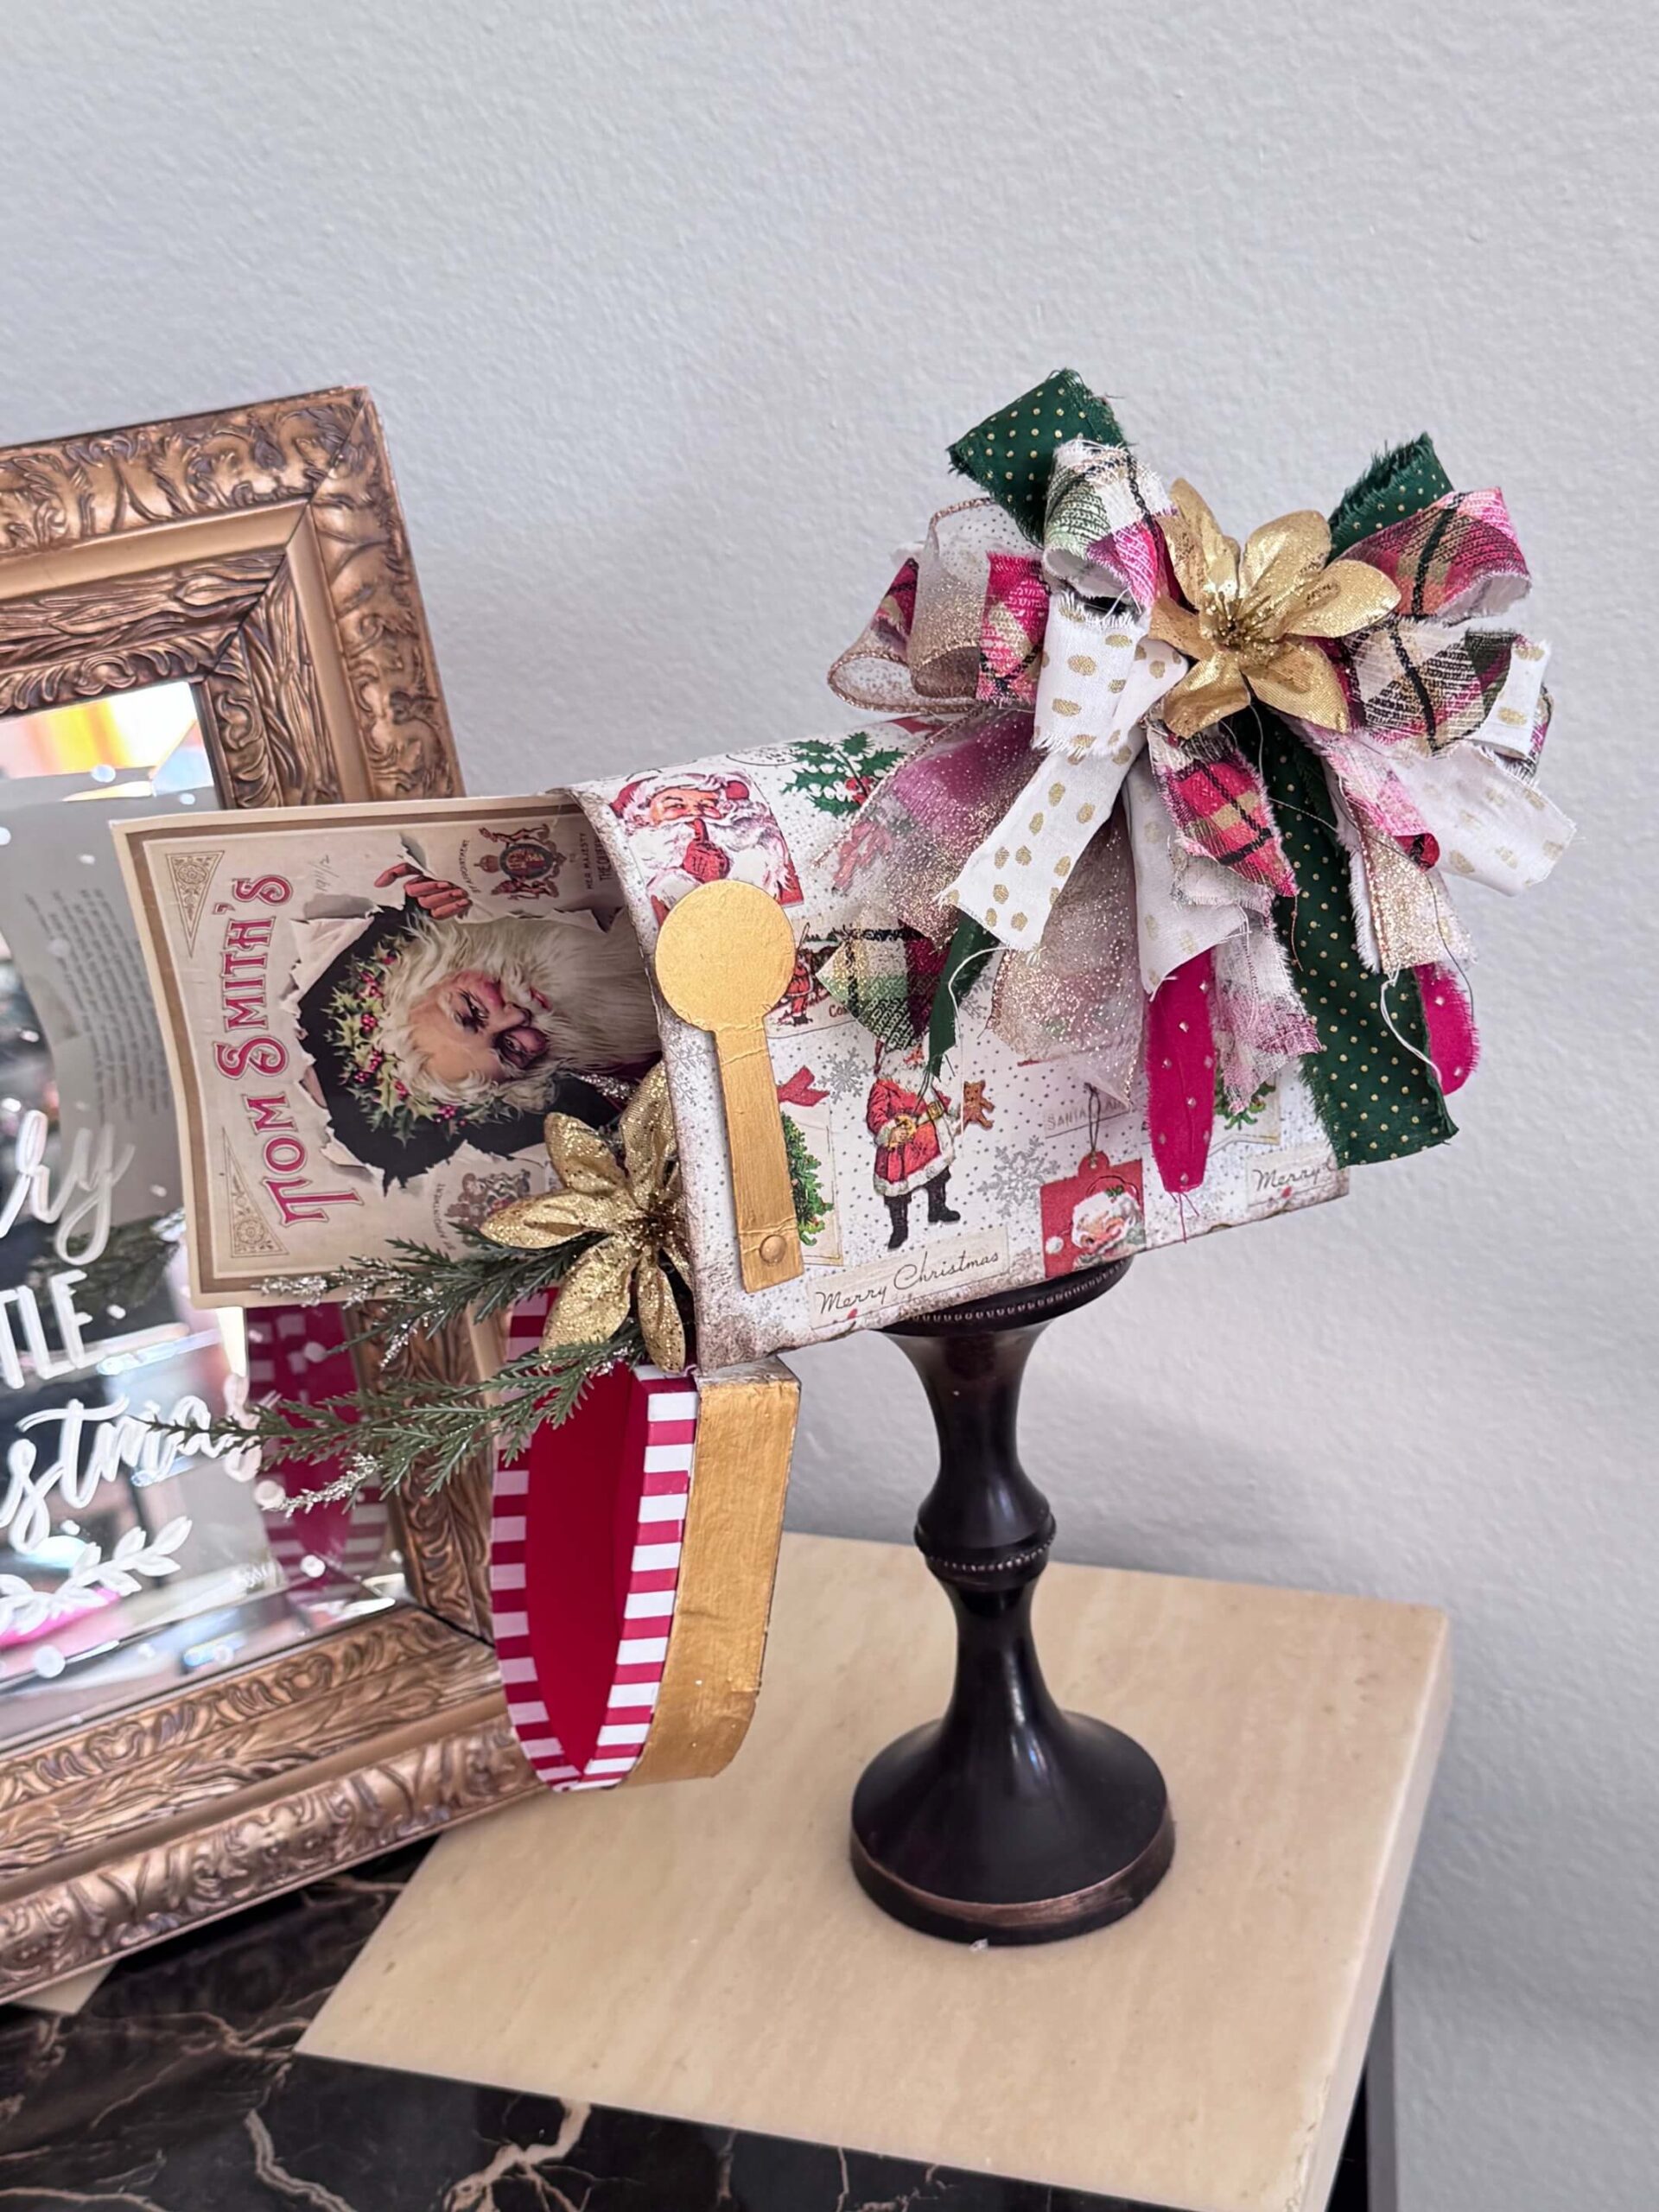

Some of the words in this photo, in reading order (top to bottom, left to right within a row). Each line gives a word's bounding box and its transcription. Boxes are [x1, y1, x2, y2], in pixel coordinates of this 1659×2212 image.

[579, 832, 591, 869] MAJESTY
[594, 835, 610, 865] QUE
[585, 873, 594, 890] HER
[598, 865, 613, 881] THE
[213, 874, 294, 1081] SMITH'S
[243, 1092, 365, 1227] TOM
[1251, 1166, 1321, 1192] Merry
[433, 1182, 448, 1240] APPOINTMENT
[816, 1285, 887, 1314] Merry
[893, 1249, 999, 1290] Christmas
